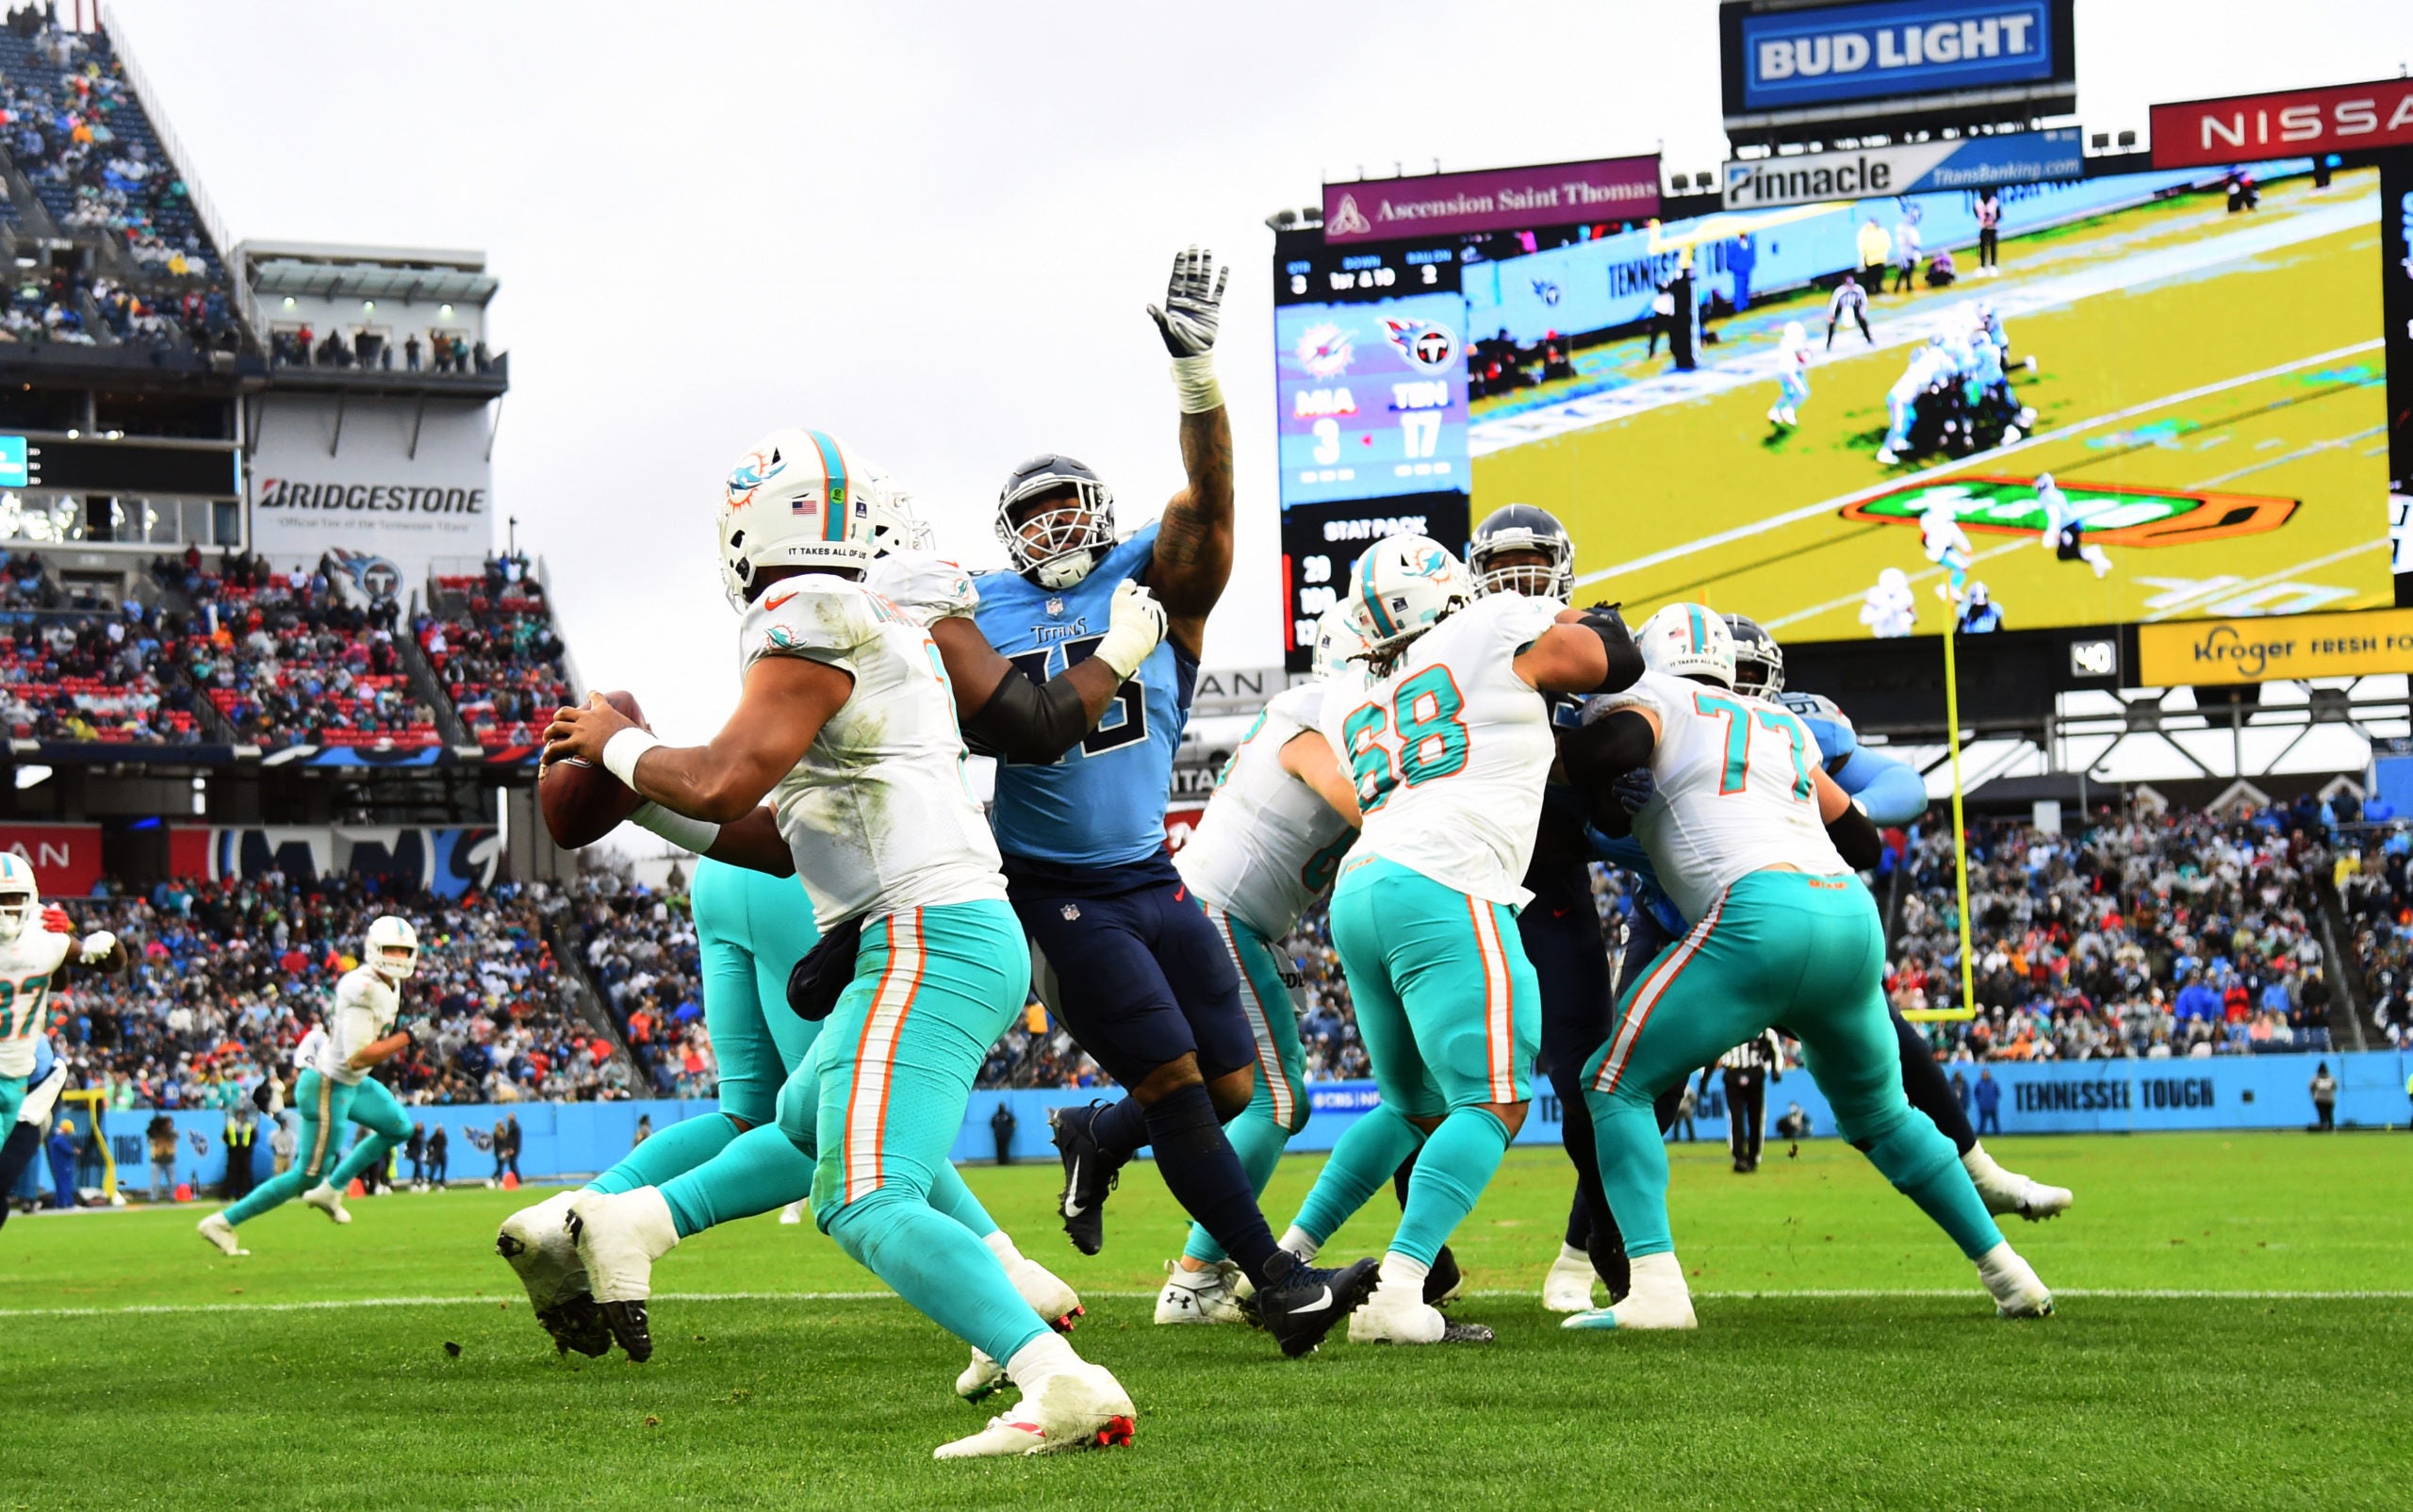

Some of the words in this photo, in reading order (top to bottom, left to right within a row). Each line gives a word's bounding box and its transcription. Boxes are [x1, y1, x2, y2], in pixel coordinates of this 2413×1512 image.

[1759, 32, 1871, 81] BUD
[1876, 14, 2033, 69] LIGHT
[1730, 156, 1892, 204] Pinnacle
[1933, 158, 2080, 186] TitansBanking.com
[1375, 194, 1495, 222] Ascension
[1498, 182, 1560, 210] Saint
[1562, 179, 1659, 206] Thomas
[1342, 255, 1381, 271] DOWN
[1294, 387, 1355, 416] MIA
[1313, 418, 1340, 465] 3
[1400, 410, 1442, 458] 17
[259, 479, 486, 514] BRIDGESTONE
[2195, 626, 2297, 677] Kroger
[2311, 637, 2378, 654] FRESH
[1343, 664, 1470, 815] 68
[1693, 691, 1814, 803] 77
[2015, 1080, 2131, 1112] TENNESSEE
[2144, 1077, 2214, 1109] TOUGH
